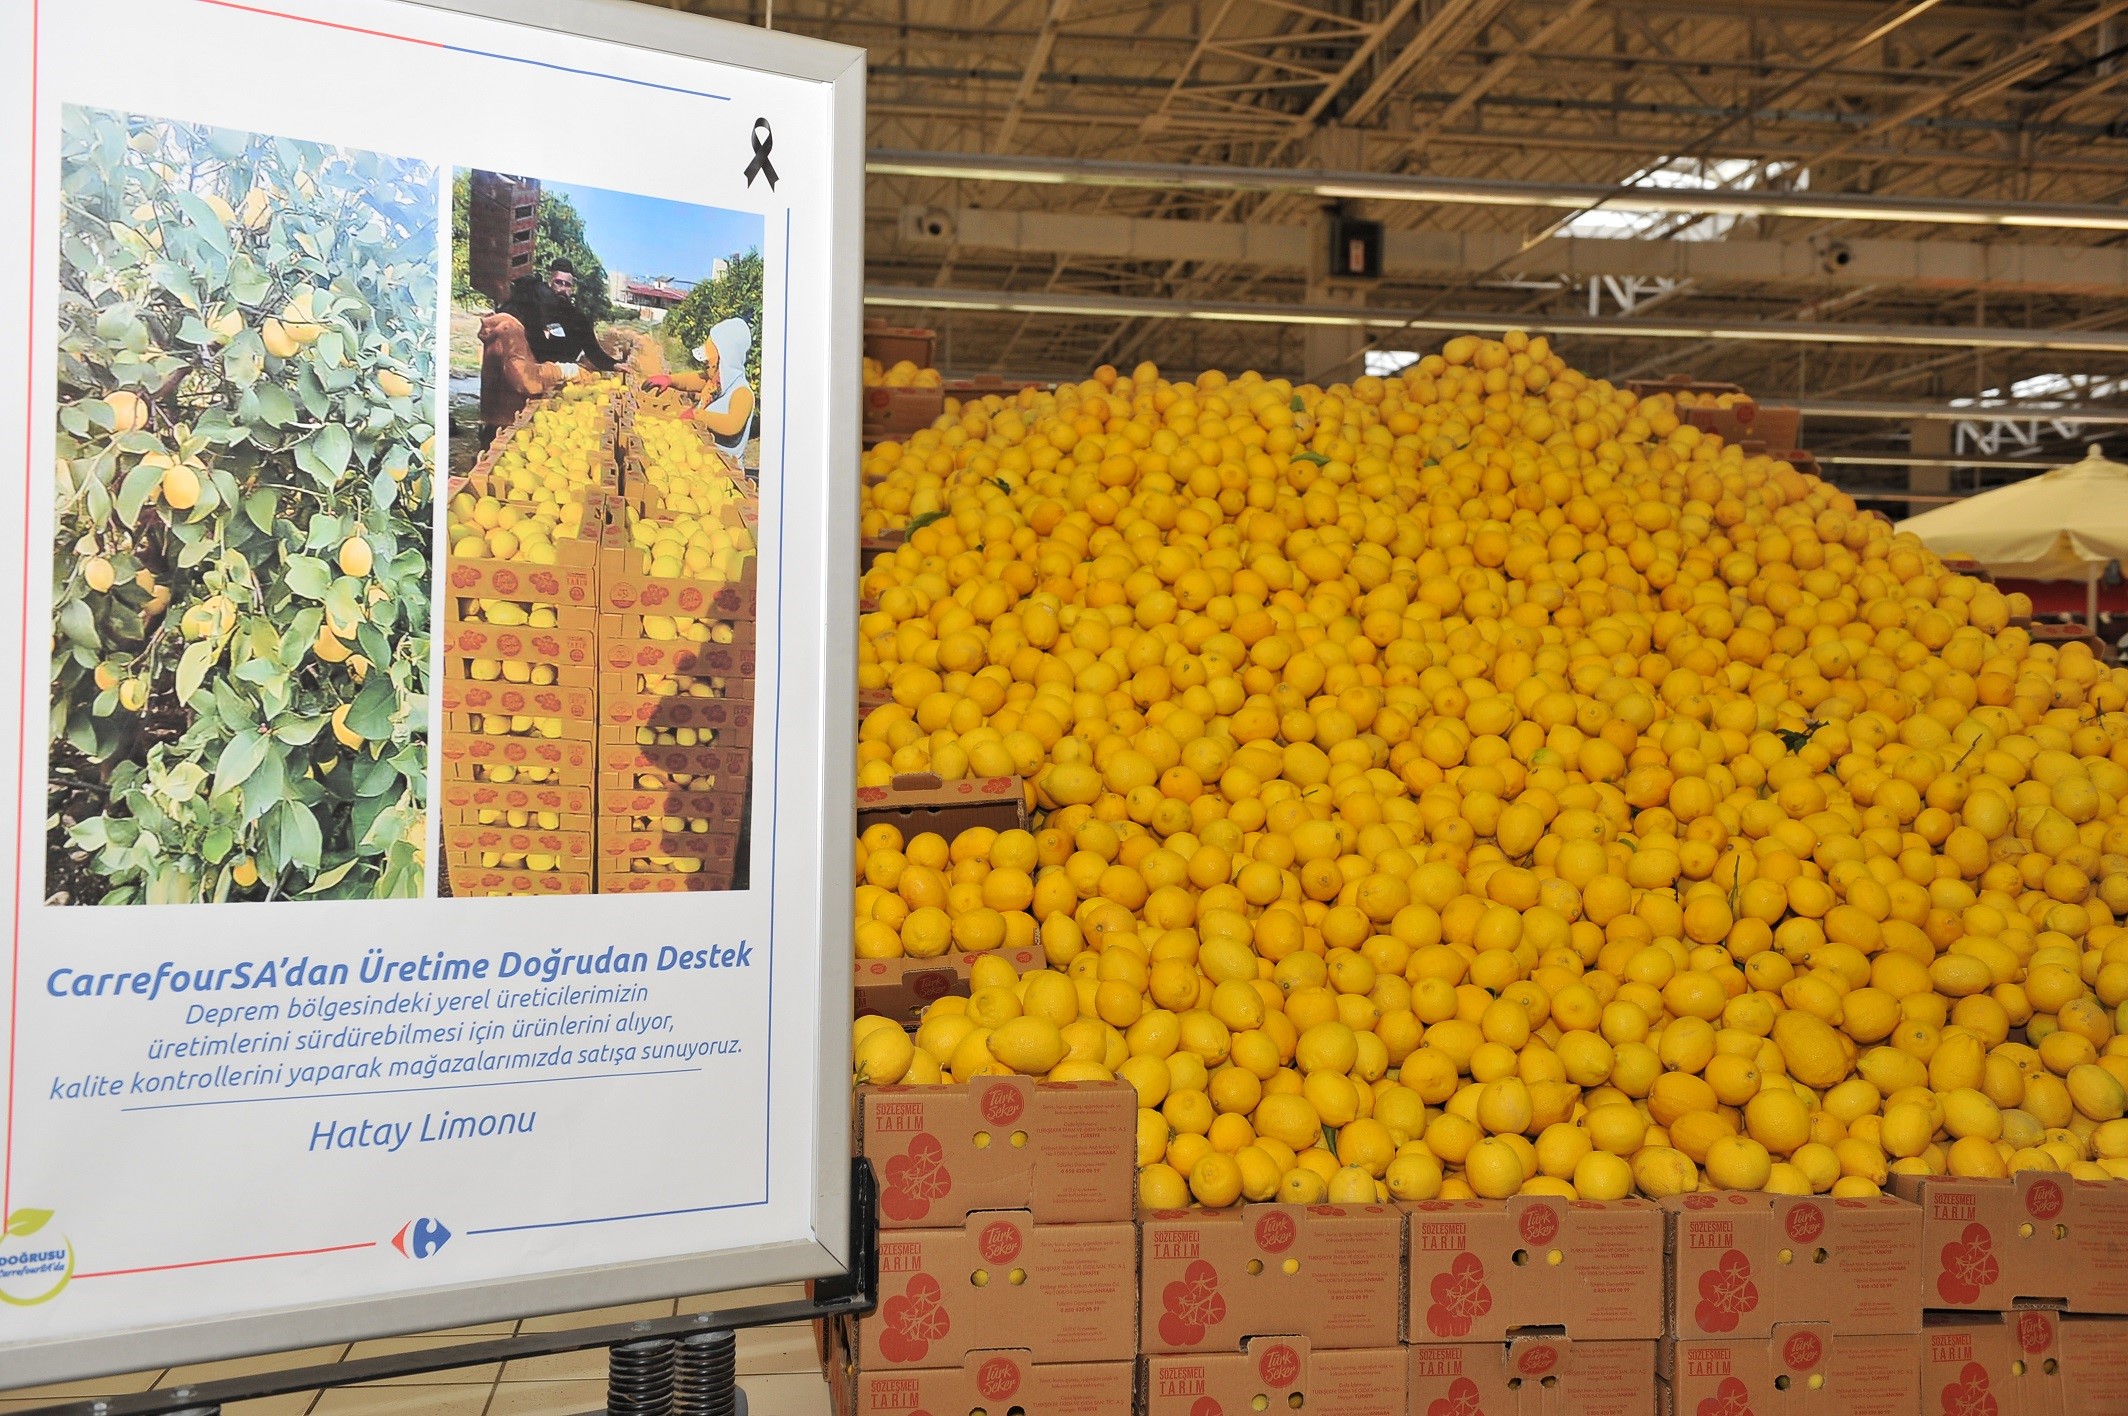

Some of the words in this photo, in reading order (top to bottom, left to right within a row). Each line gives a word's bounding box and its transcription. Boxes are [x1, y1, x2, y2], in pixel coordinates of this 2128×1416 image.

[47, 956, 349, 1000] CarrefourSA'dan
[360, 948, 490, 984] Üretime
[498, 946, 649, 984] Doğrudan
[656, 940, 753, 972] Destek
[185, 1004, 280, 1027] Deprem
[287, 993, 430, 1021] bölgesindeki
[434, 989, 490, 1016] yerel
[497, 983, 648, 1009] üreticilerimizin
[148, 1031, 290, 1060] üretimlerini
[295, 1021, 462, 1050] sürdürebilmesi
[469, 1020, 505, 1043] için
[512, 1014, 611, 1039] ürünlerini
[616, 1012, 673, 1034] alıyor,
[50, 1074, 124, 1099] kalite
[131, 1063, 283, 1092] kontrollerini
[286, 1057, 382, 1089] yaparak
[388, 1046, 573, 1079] mağazalarımızda
[577, 1045, 636, 1065] satışa
[640, 1038, 742, 1060] sunuyoruz.
[989, 1089, 1015, 1106] Türk
[876, 1103, 923, 1116] SÖZLEŞMELİ
[876, 1116, 923, 1130] TARIM
[309, 1118, 412, 1153] Hatay
[420, 1111, 536, 1143] Limonu
[2032, 1185, 2056, 1200] Türk
[1934, 1194, 1976, 1206] SÖZLEŞMELİ
[1526, 1210, 1551, 1227] Türk
[1792, 1209, 1816, 1225] Türk
[1934, 1206, 1975, 1219] TARIM
[1263, 1217, 1288, 1233] Türk
[1422, 1224, 1466, 1235] SÖZLEŞMELİ
[1690, 1222, 1733, 1233] SÖZLEŞMELİ
[987, 1228, 1013, 1244] Türk
[1154, 1232, 1199, 1244] SÖZLEŞMELİ
[1422, 1236, 1466, 1249] TARIM
[1690, 1234, 1733, 1247] TARIM
[1155, 1244, 1199, 1257] TARIM
[883, 1256, 921, 1270] ARIM
[2023, 1318, 2044, 1333] Türk
[1791, 1337, 1815, 1353] Türk
[1267, 1351, 1292, 1367] Türk
[1527, 1349, 1550, 1362] Türk
[1688, 1350, 1730, 1361] SÖZLEŞMELİ
[1932, 1347, 1971, 1360] TARIM
[985, 1364, 1012, 1381] Türk
[1159, 1368, 1205, 1380] SÖZLEŞMELİ
[1419, 1361, 1462, 1375] TARIM
[1688, 1361, 1730, 1375] TARIM
[871, 1380, 919, 1393] SÖZLEŞMELİ
[1160, 1380, 1205, 1395] TARIM
[871, 1393, 919, 1408] TARIM
